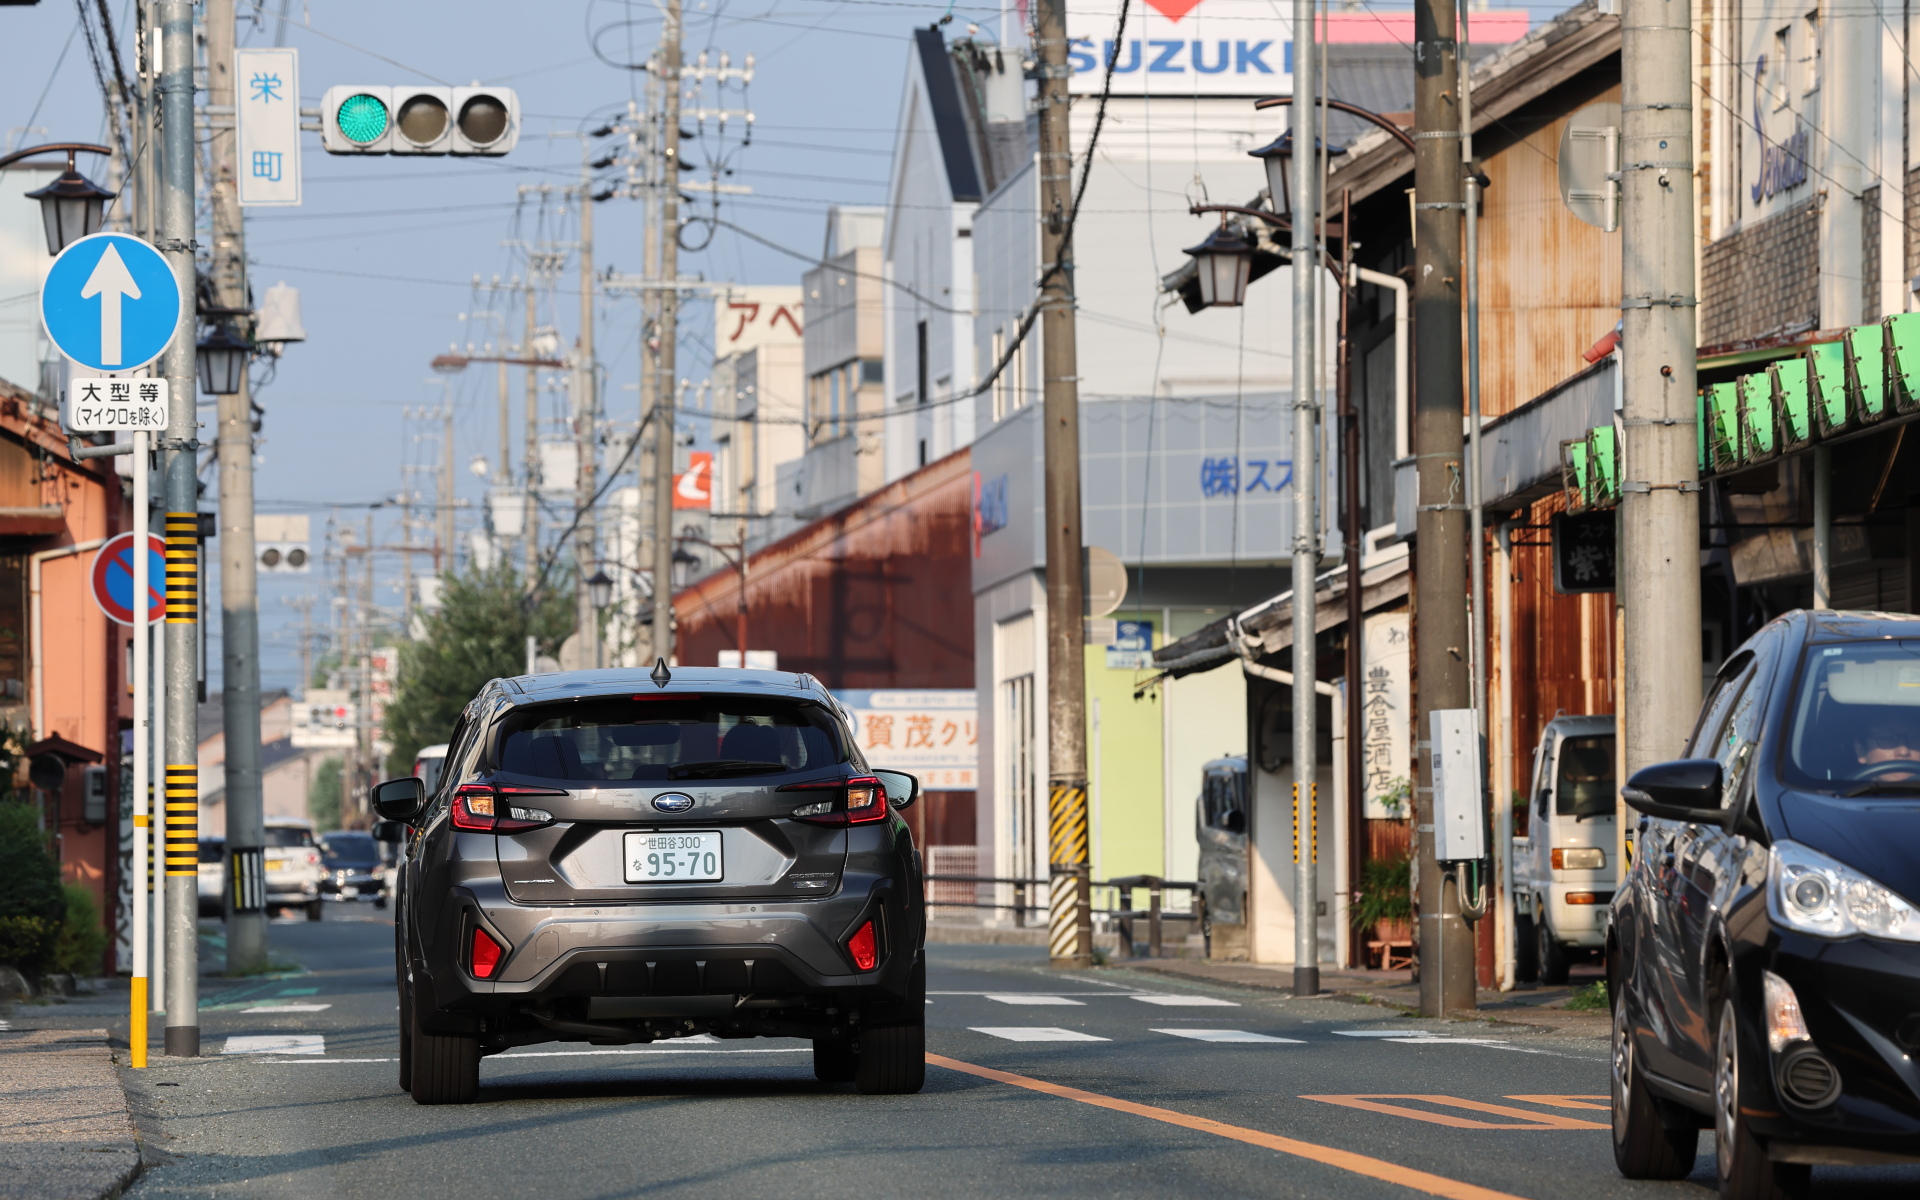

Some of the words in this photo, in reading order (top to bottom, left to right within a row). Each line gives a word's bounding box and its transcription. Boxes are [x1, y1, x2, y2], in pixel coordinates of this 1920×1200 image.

[1067, 39, 1293, 74] SUZUKI
[250, 72, 283, 182] 栄町
[81, 383, 158, 402] 大型等
[76, 406, 164, 426] (マイクロを除く)
[865, 713, 979, 749] 賀茂クリ
[632, 859, 642, 871] な
[647, 852, 716, 876] 95-70
